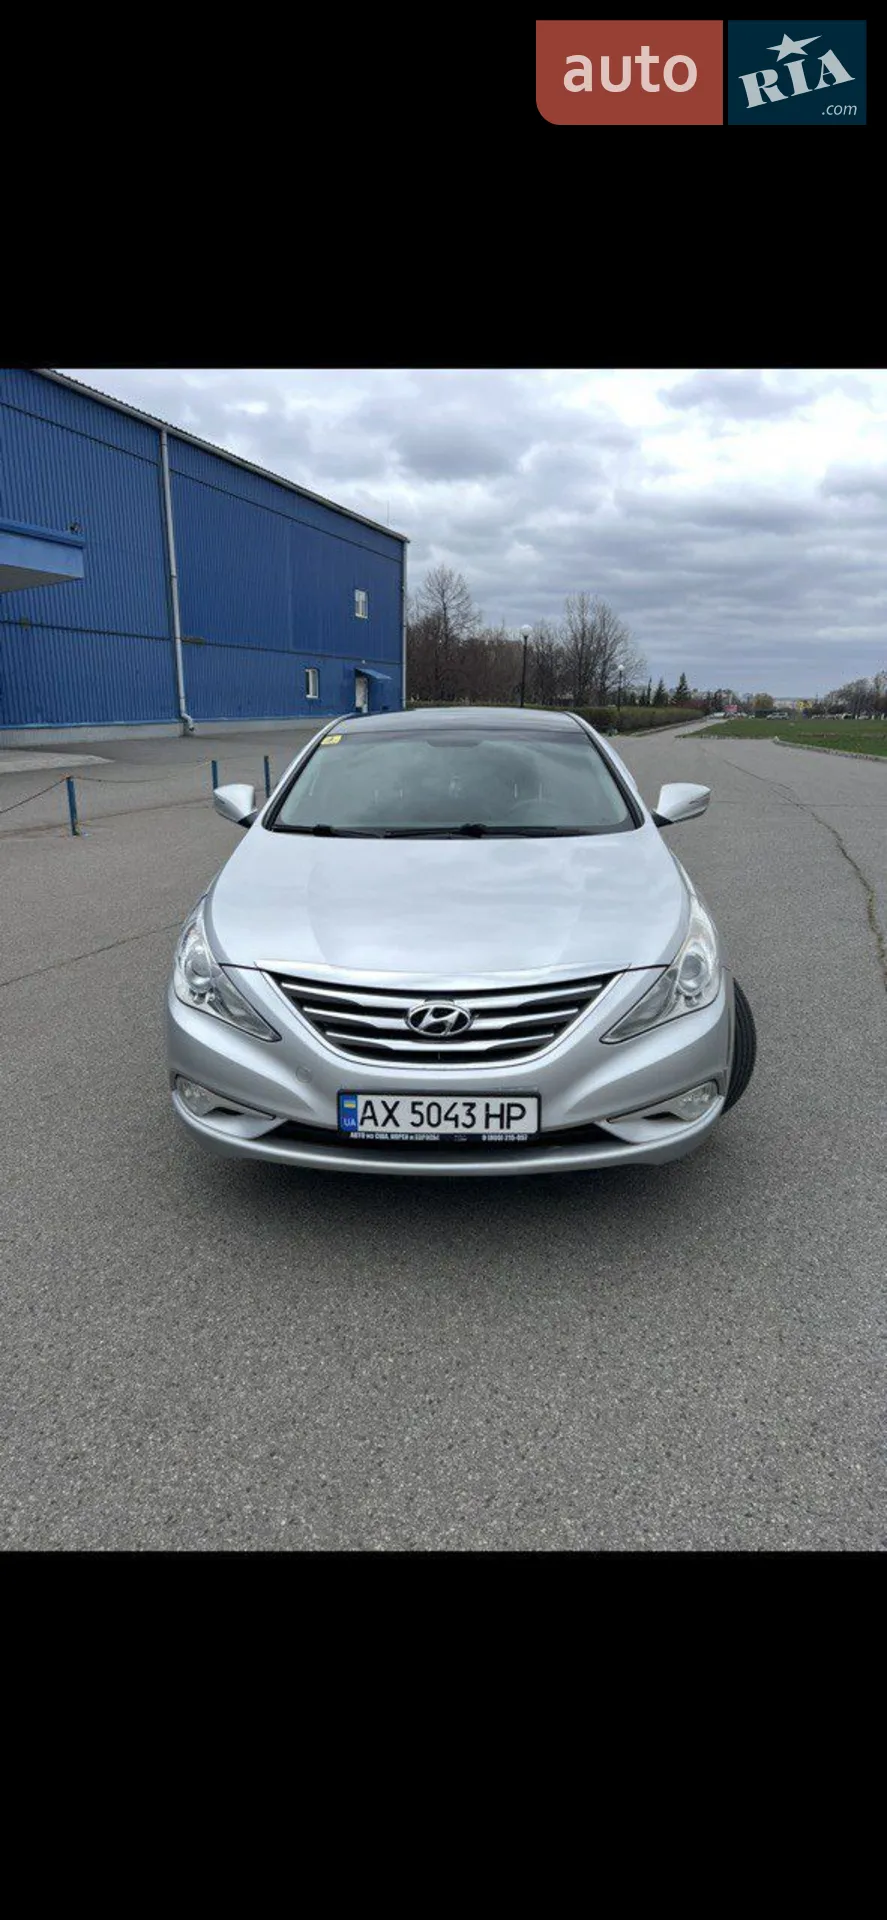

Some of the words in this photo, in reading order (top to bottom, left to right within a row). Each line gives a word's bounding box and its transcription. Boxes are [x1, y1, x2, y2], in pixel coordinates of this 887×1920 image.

[343, 1118, 356, 1127] UA
[359, 1100, 400, 1127] AX
[410, 1102, 476, 1129] 5043
[484, 1102, 527, 1129] HP
